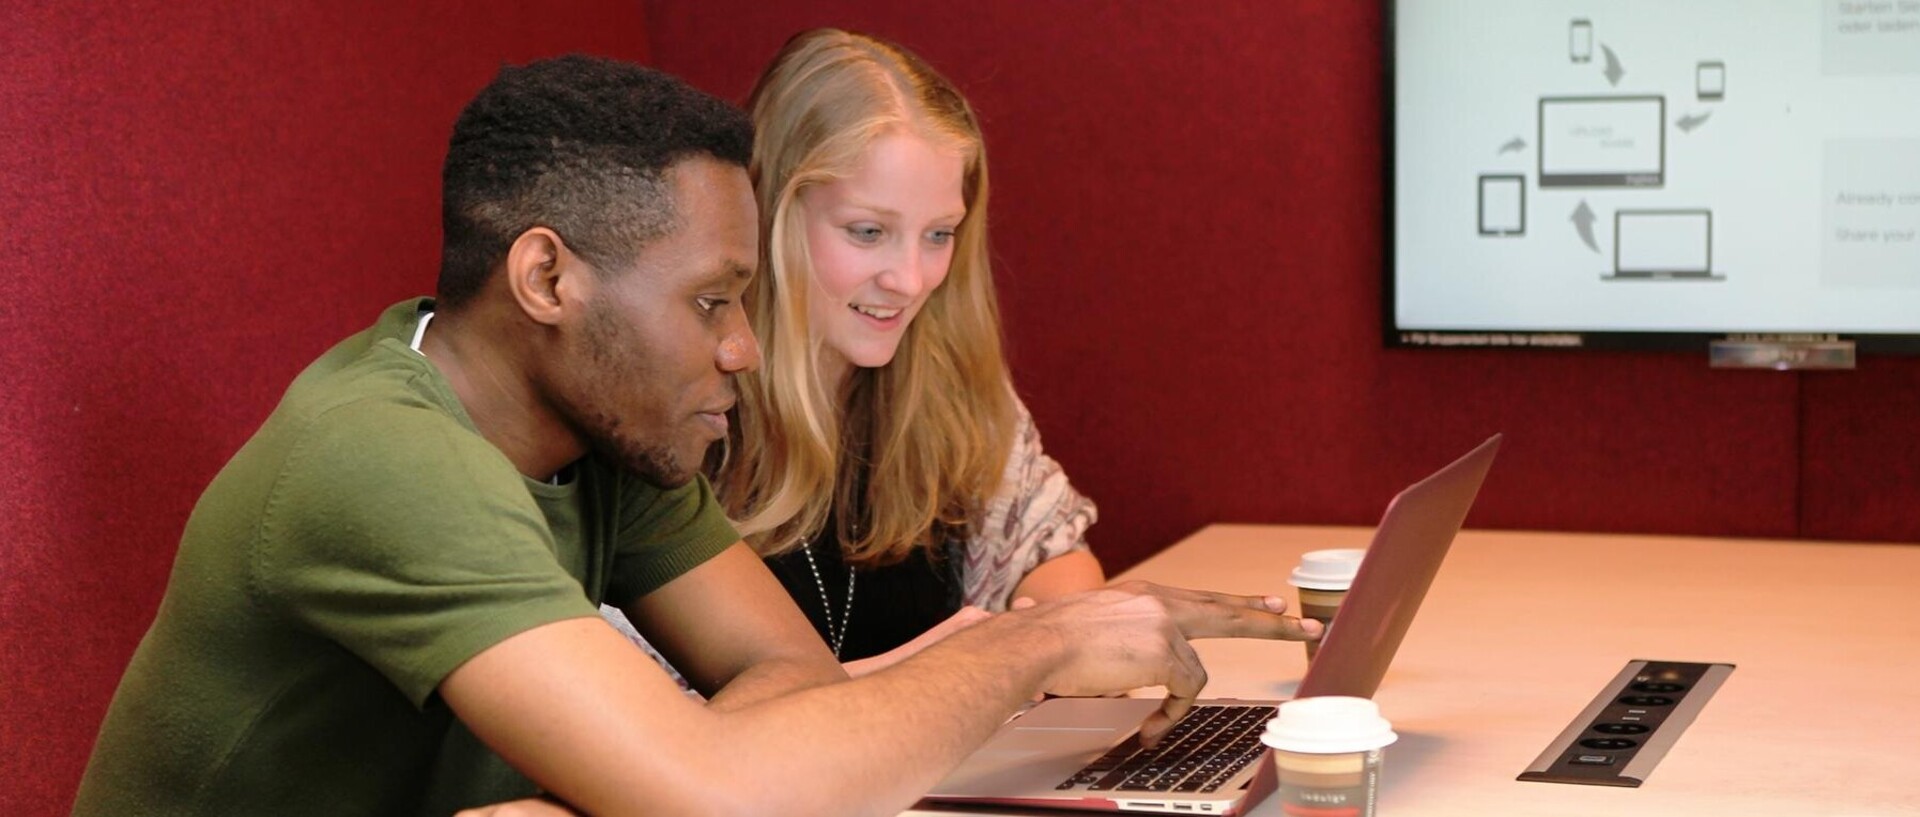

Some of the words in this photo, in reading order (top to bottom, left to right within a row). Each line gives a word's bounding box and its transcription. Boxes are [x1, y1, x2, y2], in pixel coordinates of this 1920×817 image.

[1836, 190, 1893, 208] Already
[1836, 229, 1879, 242] Share
[1883, 230, 1915, 245] your
